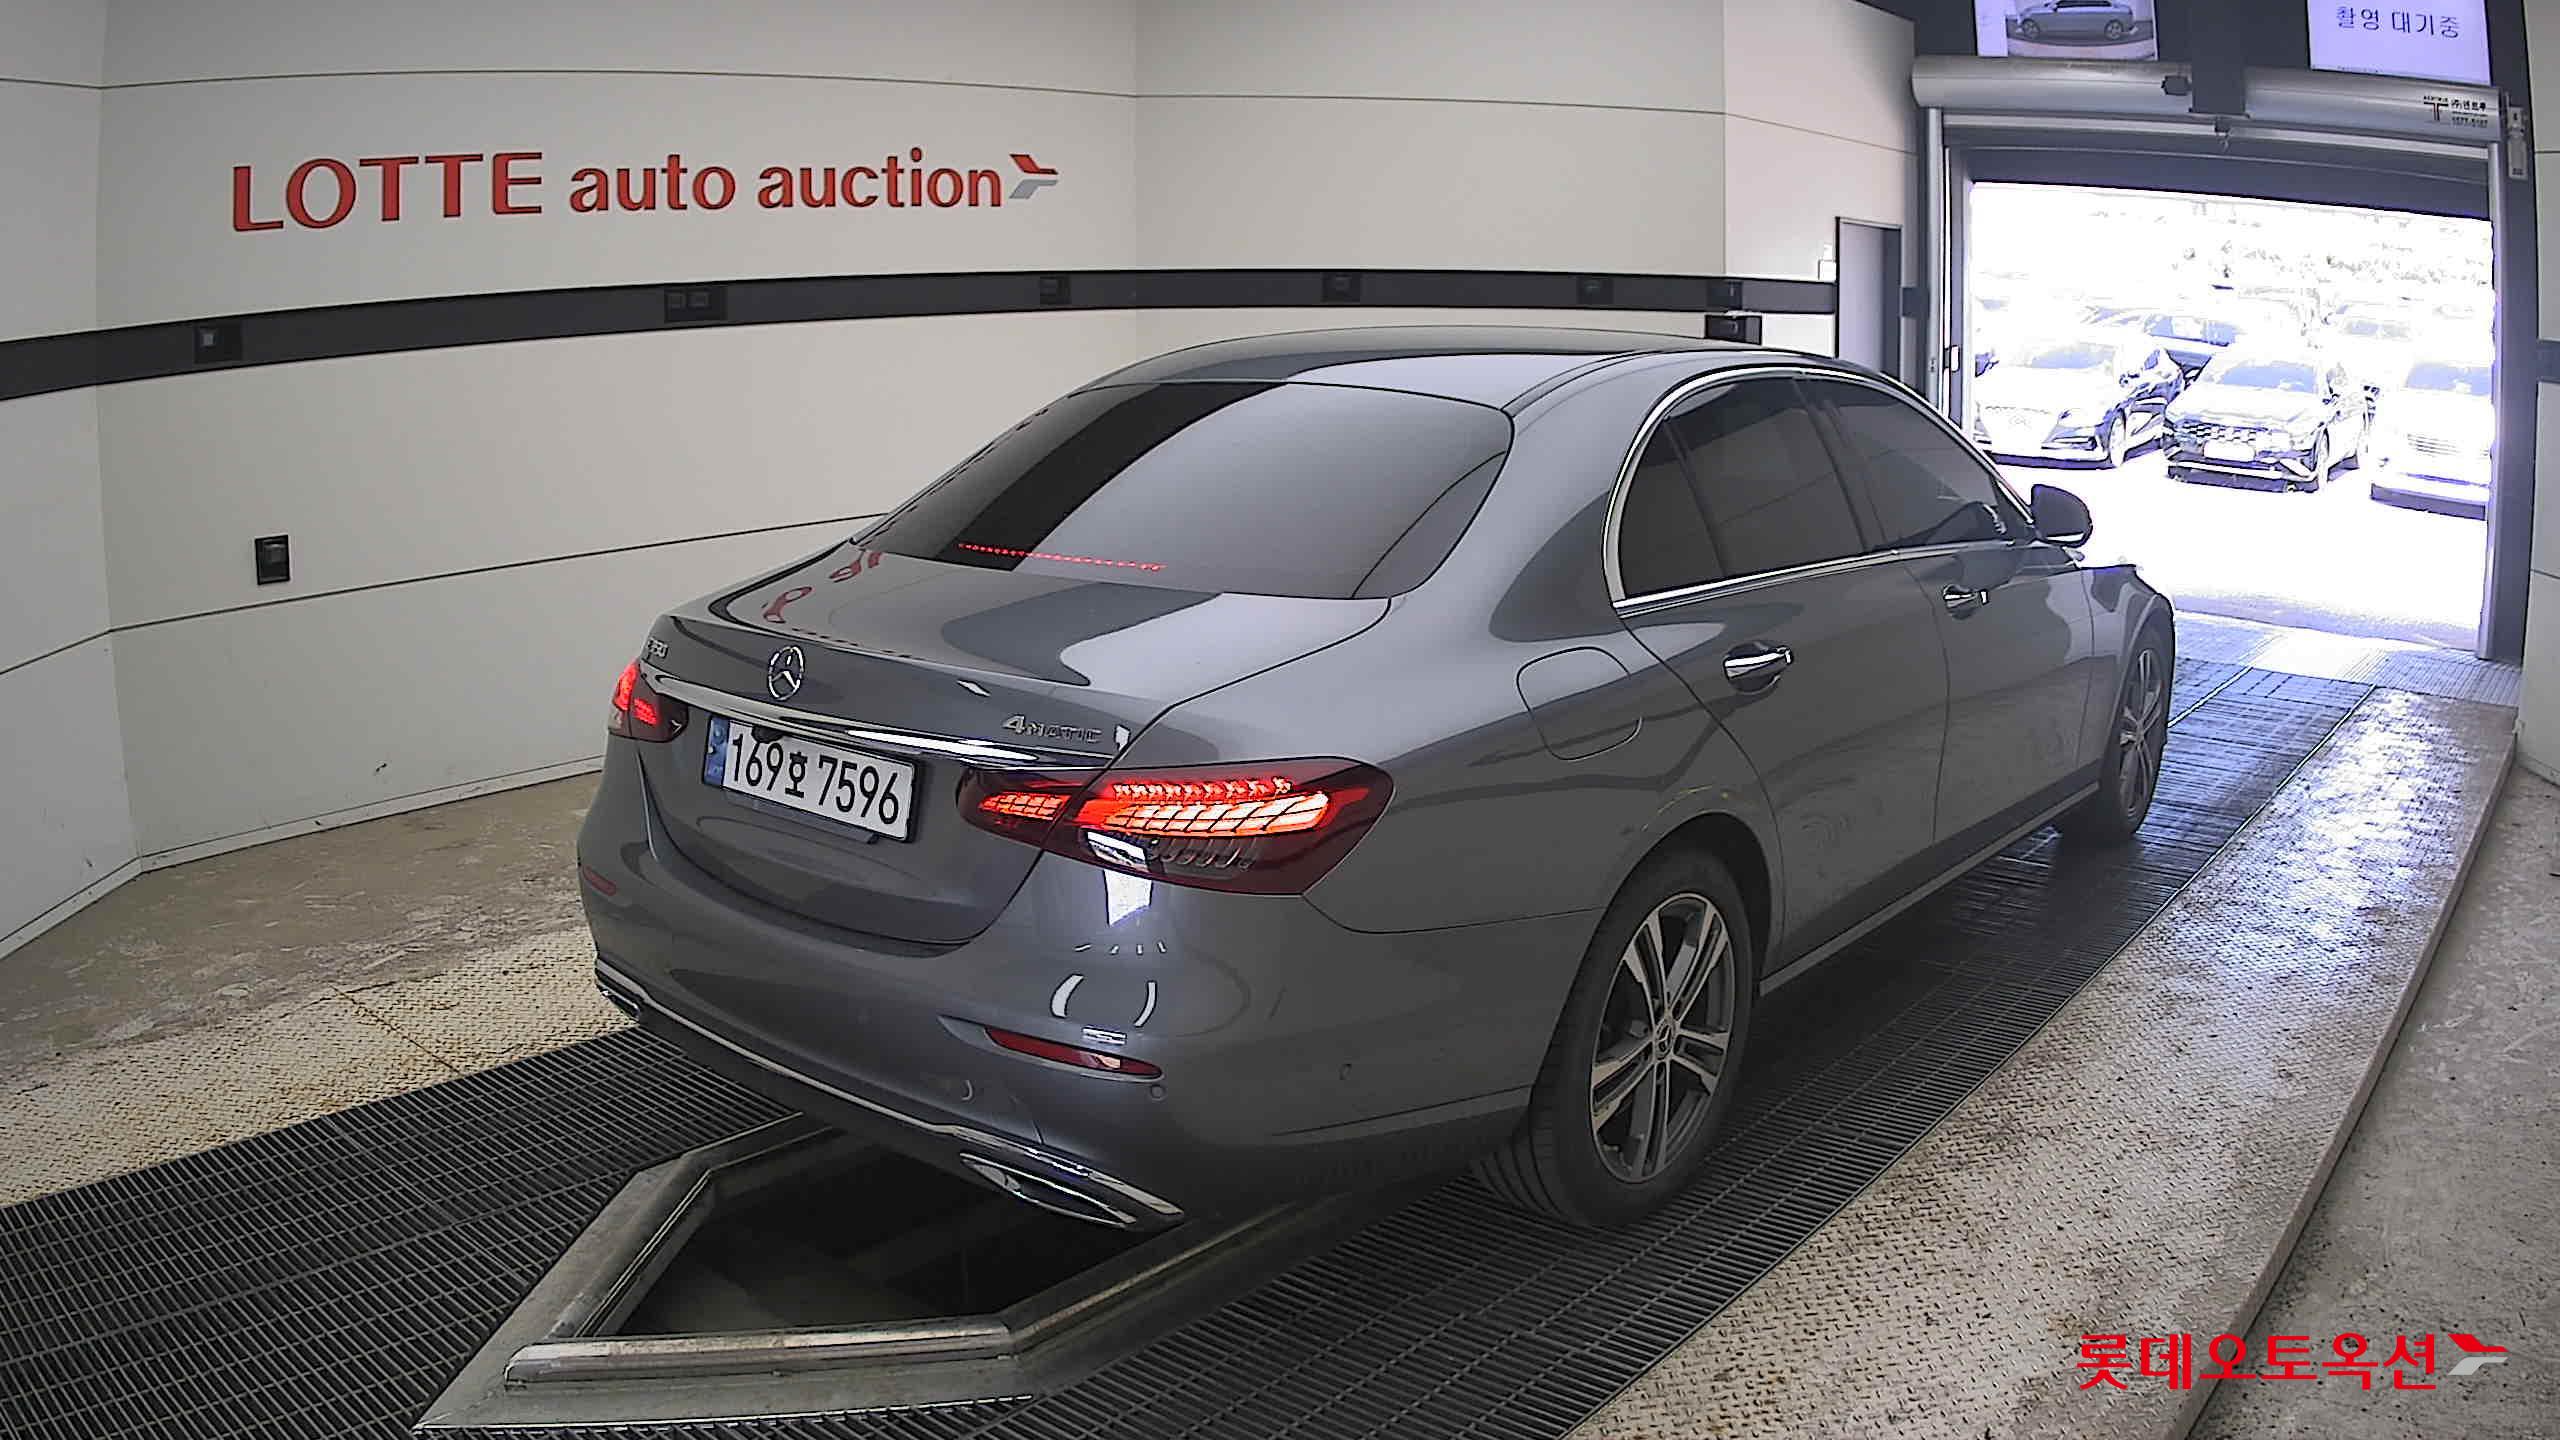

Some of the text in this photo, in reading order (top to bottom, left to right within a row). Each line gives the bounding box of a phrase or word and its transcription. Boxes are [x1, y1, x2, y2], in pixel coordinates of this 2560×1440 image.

[2391, 10, 2459, 39] 대기중
[232, 146, 1002, 232] LOTTE auto auction
[817, 752, 900, 826] 7596
